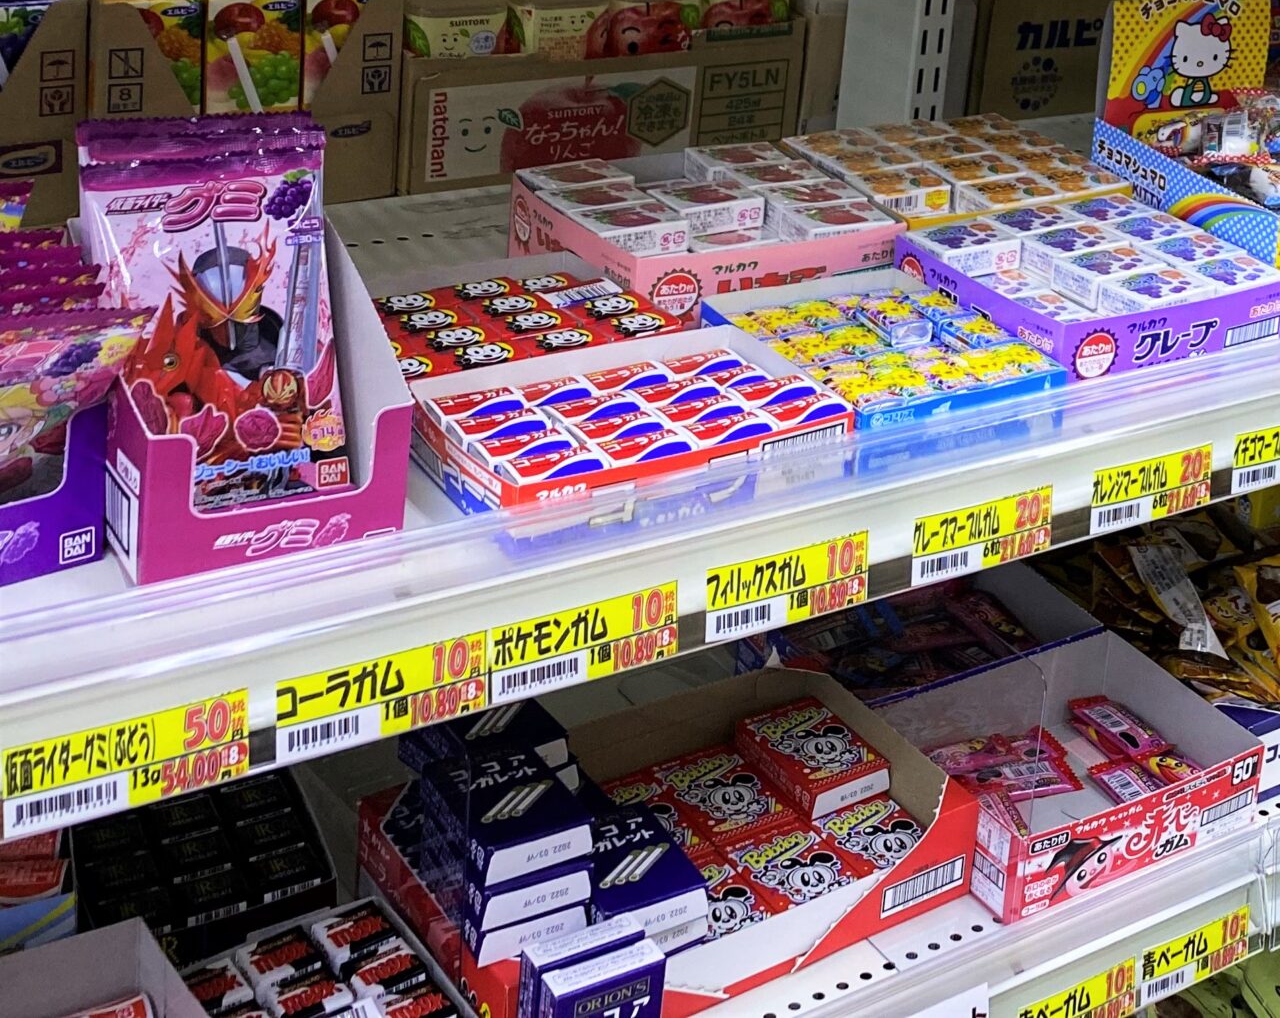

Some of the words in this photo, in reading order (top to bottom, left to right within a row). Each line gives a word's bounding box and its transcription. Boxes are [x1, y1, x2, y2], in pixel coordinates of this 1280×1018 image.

[165, 4, 199, 18] エルビー
[266, 0, 299, 13] エルビー
[449, 17, 491, 28] SUNTORY
[708, 67, 782, 93] FY5LN
[546, 104, 602, 121] SUNTORY
[430, 90, 449, 179] natchan!
[524, 112, 627, 147] なっちゃん!
[548, 140, 597, 160] りんご
[1096, 139, 1168, 191] チョコマシュマロ
[162, 181, 268, 232] グミ
[711, 260, 759, 275] マルカワ
[929, 268, 958, 291] マルカワ
[659, 281, 694, 296] あたり付
[1127, 316, 1168, 333] マルカワ
[1017, 326, 1054, 352] あたり付
[1081, 343, 1113, 358] あたり付
[1132, 318, 1218, 362] グレープ
[436, 387, 511, 408] コーラガム
[765, 393, 831, 414] コーラガム
[689, 411, 756, 432] コーラガム
[601, 429, 675, 453] コーラガム
[320, 461, 347, 473] BAN
[511, 446, 590, 469] コーラガム
[1179, 449, 1204, 484] 20
[320, 472, 342, 484] DAI
[1092, 460, 1169, 504] オレンジマーブルガム
[534, 483, 589, 502] マルカワ
[1151, 490, 1169, 510] 6粒
[1014, 492, 1043, 532] 20
[63, 530, 94, 548] BAN
[245, 519, 320, 557] グミ
[913, 504, 1001, 554] グレープマーブルガム
[62, 544, 87, 559] DAI
[826, 538, 855, 580] 10
[982, 538, 1001, 557] 6粒
[706, 554, 807, 607] フィリックスガム
[631, 588, 664, 632] 10
[788, 589, 809, 610] 1個
[808, 582, 848, 618] 10.80
[493, 608, 608, 666] ポケモンガム
[432, 637, 469, 684] 10
[589, 644, 612, 666] 1個
[612, 631, 656, 670] 10.80
[277, 661, 404, 722] コーラガム
[383, 697, 409, 721] 1個
[409, 684, 461, 729] 10.80
[182, 698, 231, 751] 50
[762, 704, 832, 739] Bobdog
[131, 768, 161, 792] 13g
[160, 748, 223, 797] 54.00
[667, 752, 740, 787] Bobdog
[822, 800, 897, 836] Bobdog
[1074, 816, 1107, 835] マルカワ
[742, 830, 817, 869] Bobdog
[1032, 832, 1069, 854] あたり付
[1153, 835, 1192, 860] ガム
[1023, 873, 1060, 896] お口の中が
[1221, 913, 1241, 945] 10
[1142, 931, 1208, 982] 青ベーガム
[1105, 965, 1127, 998] 10
[577, 982, 648, 1013] ORION'S
